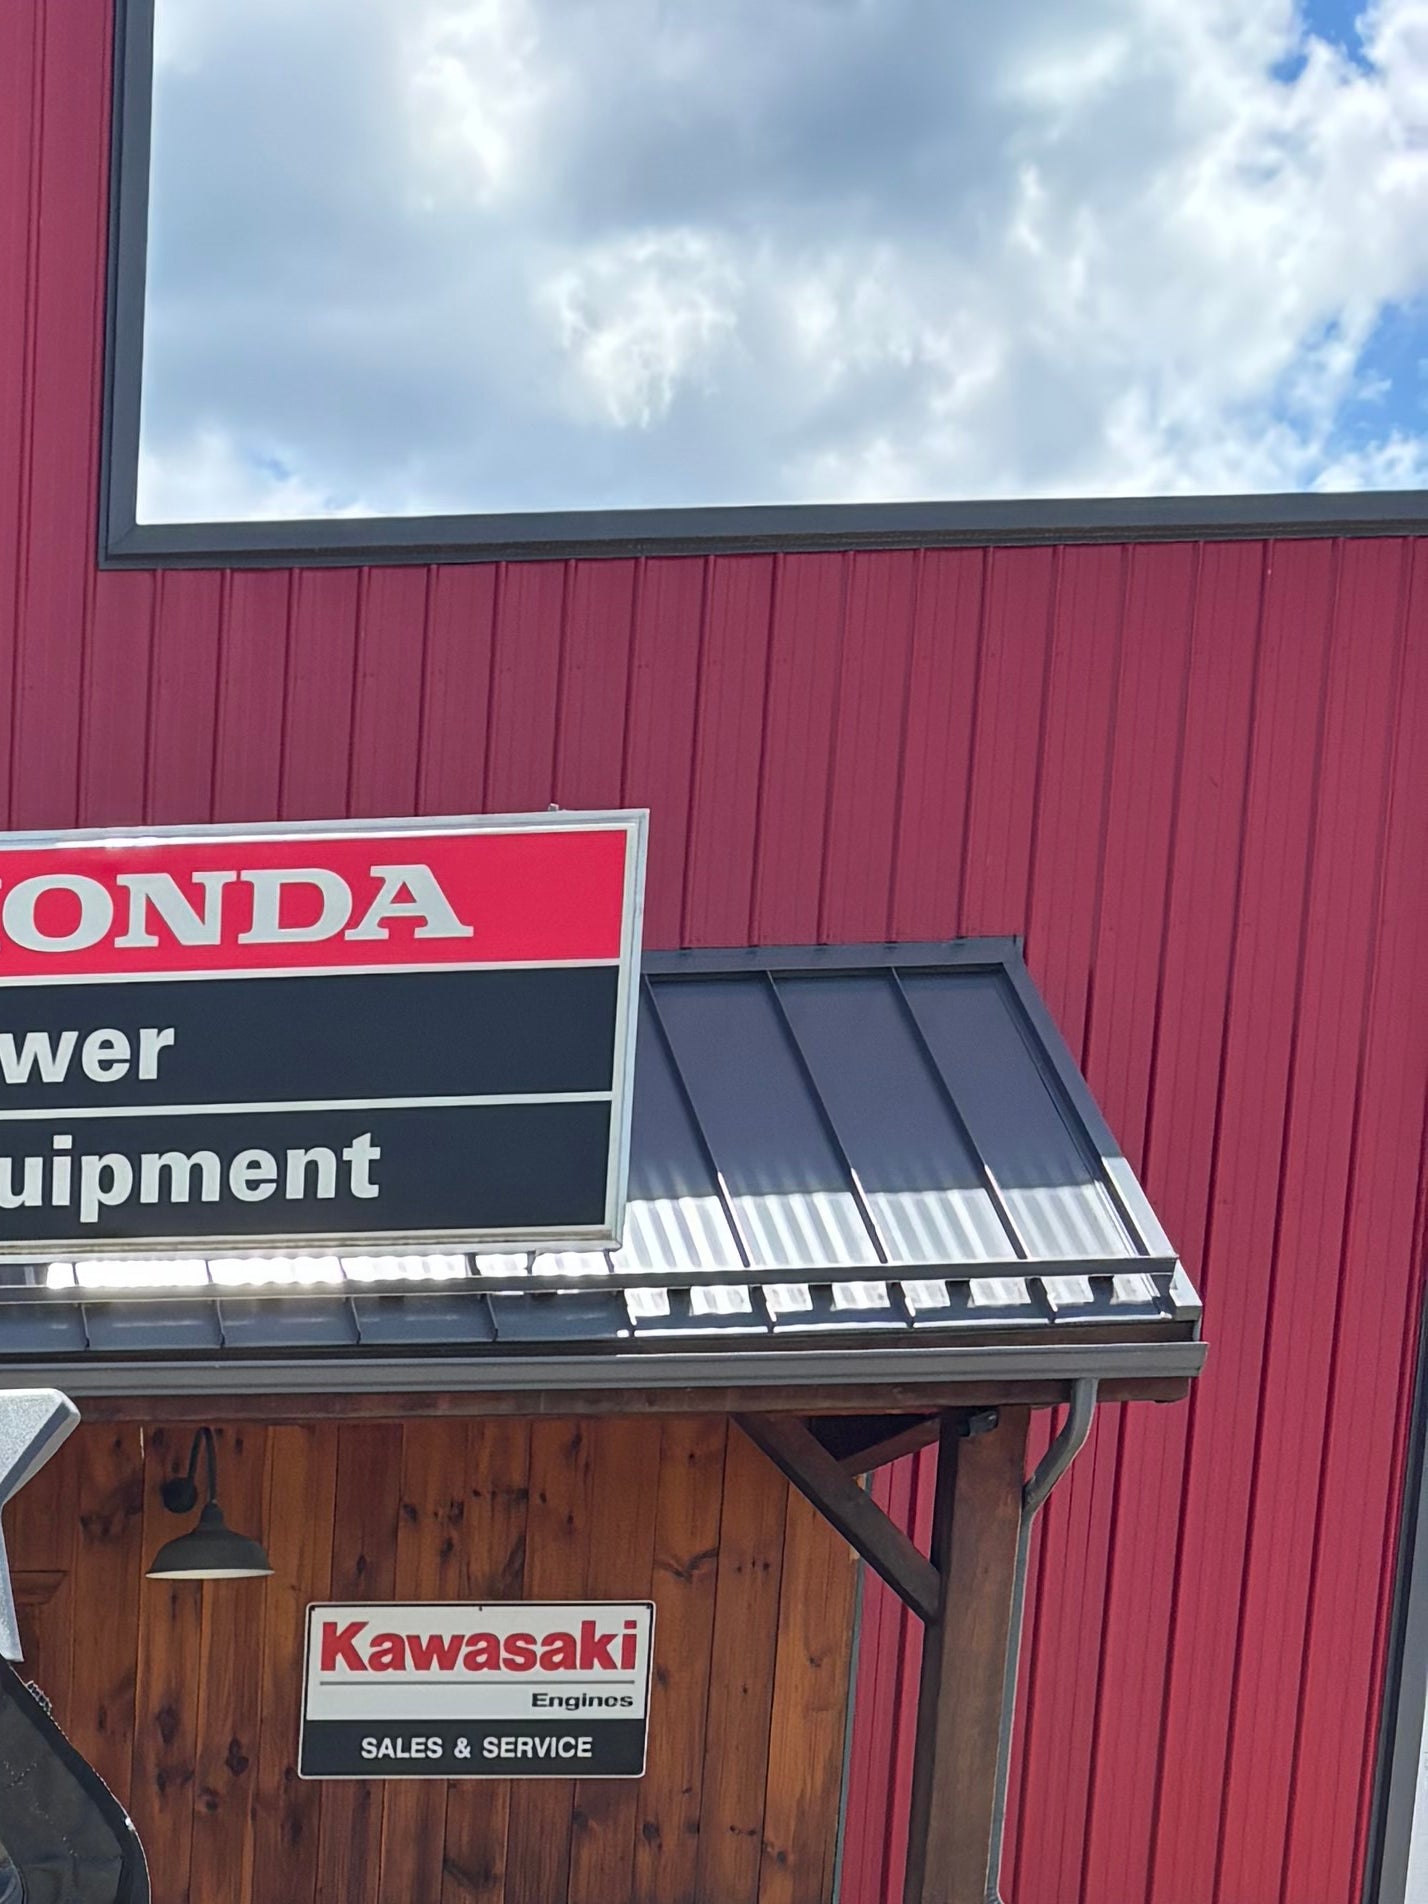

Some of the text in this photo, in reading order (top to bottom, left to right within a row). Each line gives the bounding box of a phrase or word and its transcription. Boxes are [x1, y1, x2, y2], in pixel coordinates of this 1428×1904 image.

[319, 1619, 638, 1673] Kawasaki
[531, 1692, 634, 1711] Engines
[360, 1736, 593, 1759] SALES & SERVICE
